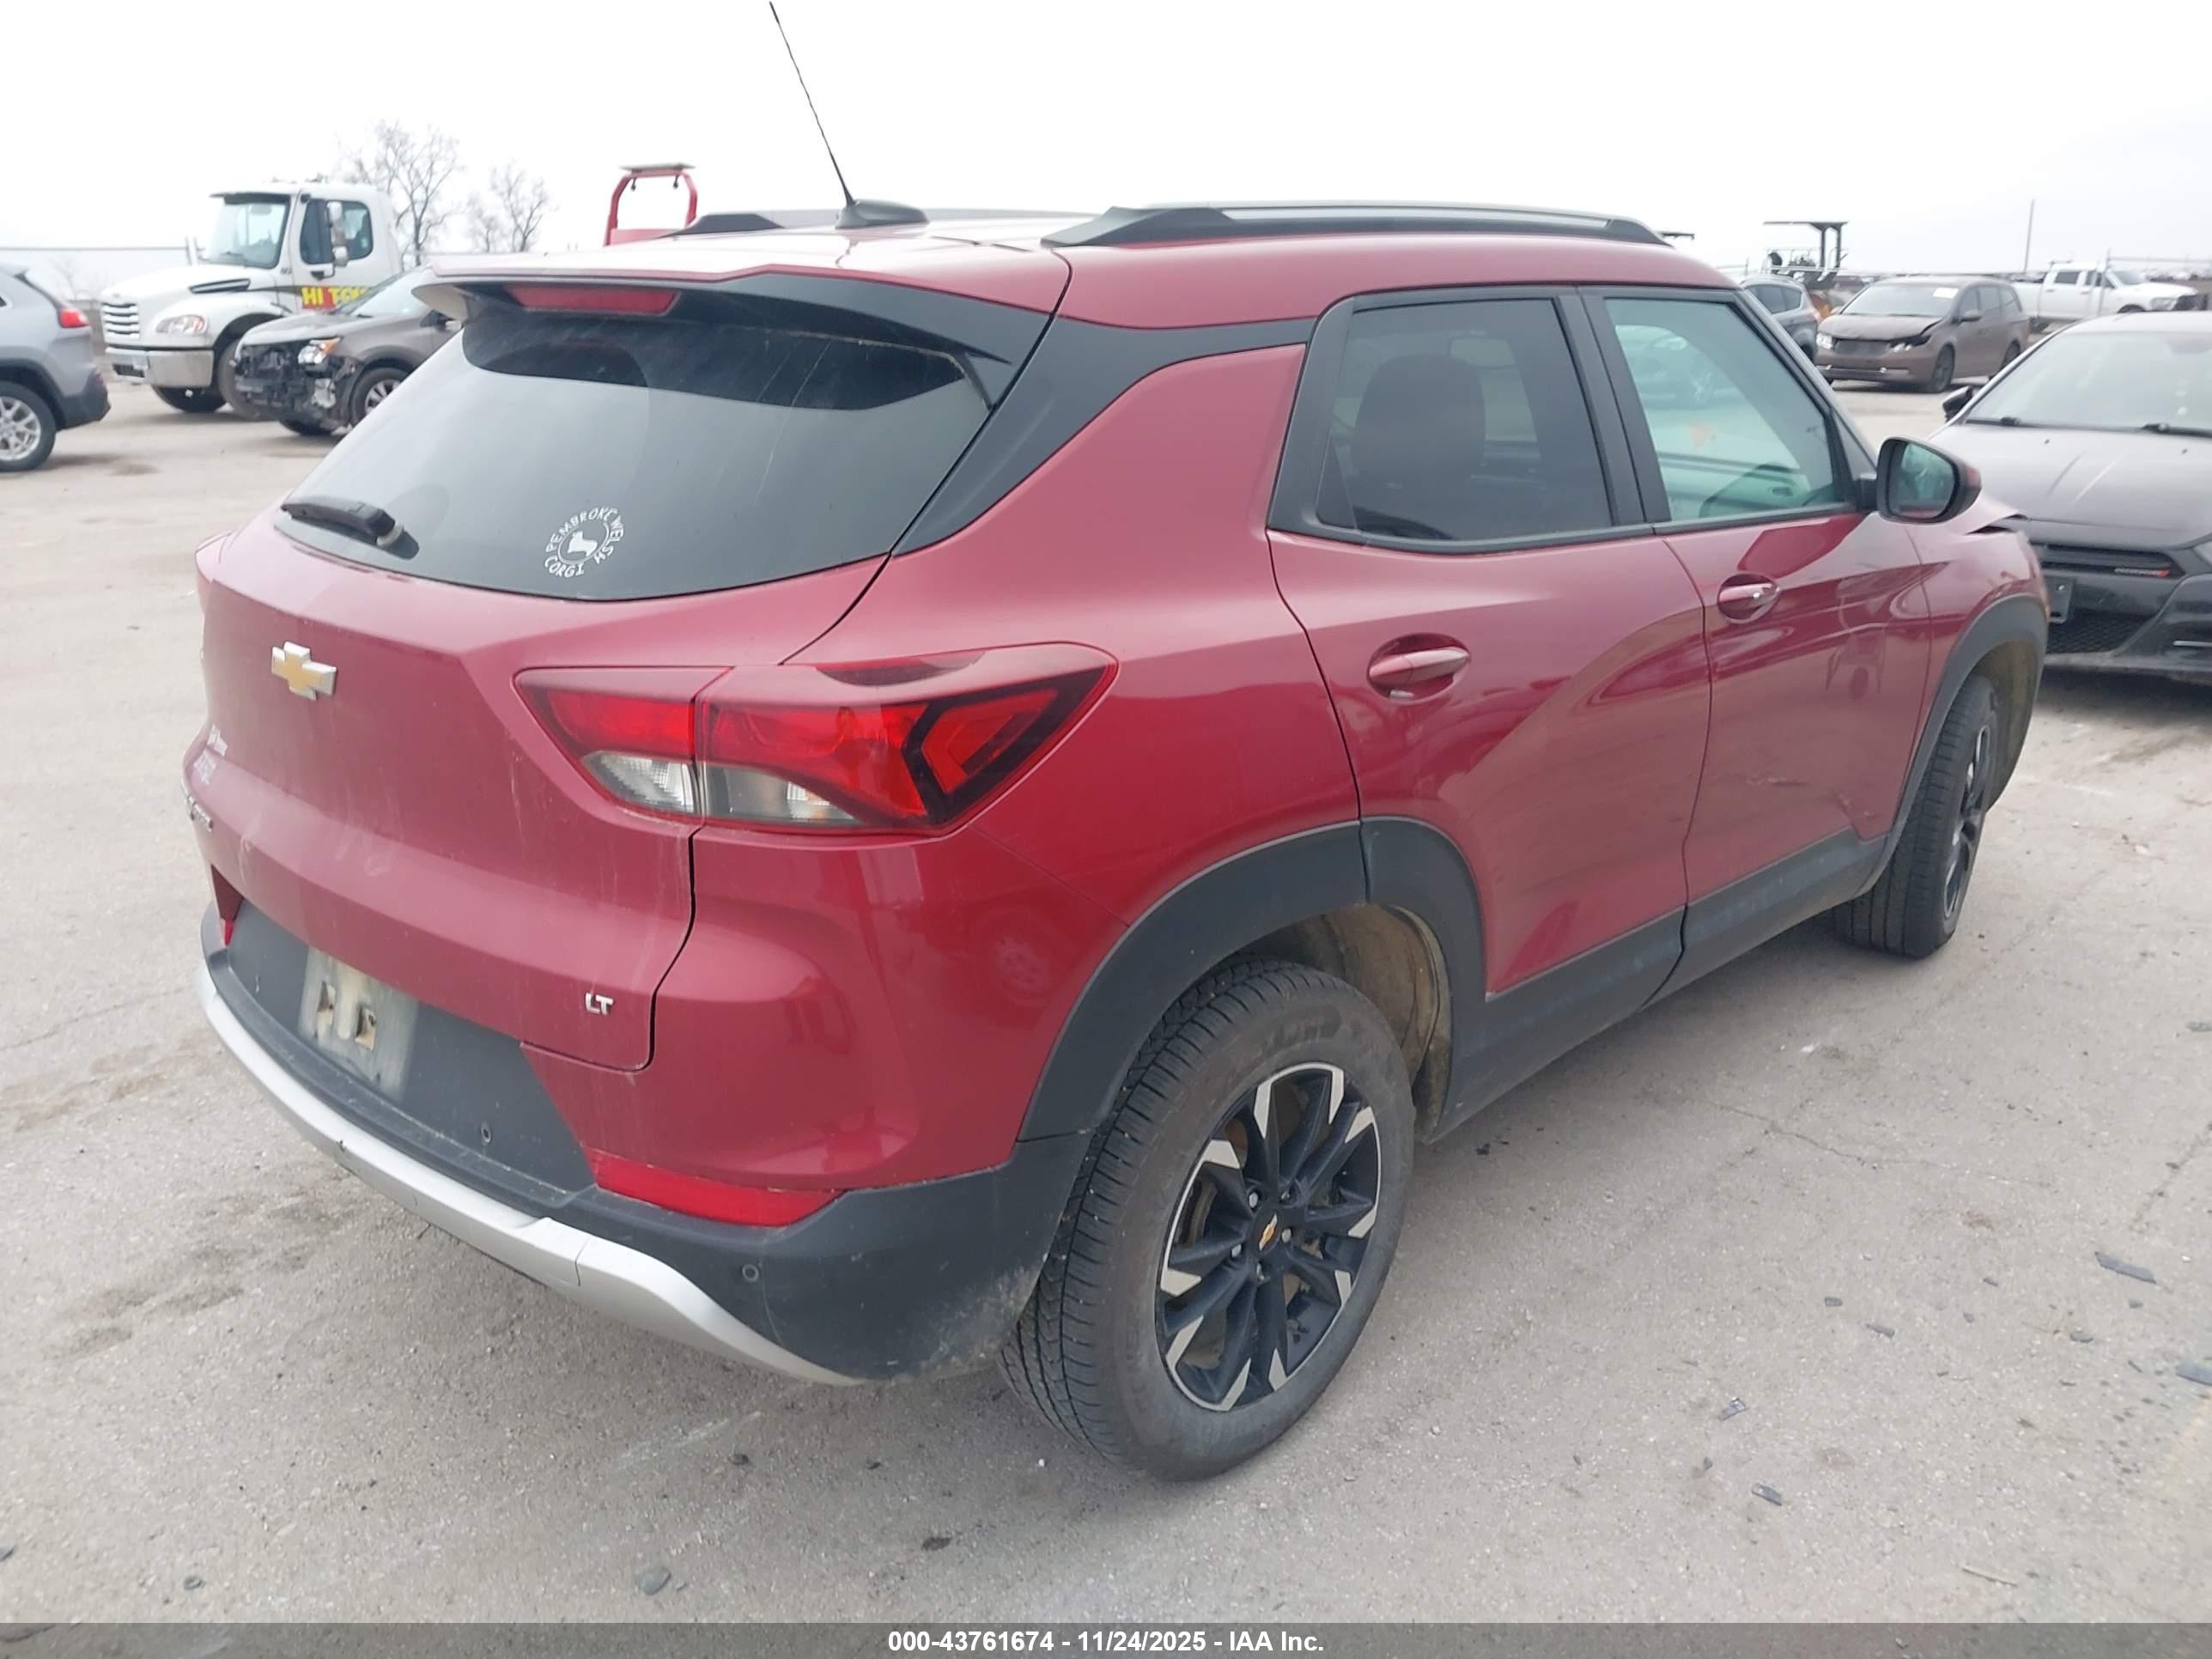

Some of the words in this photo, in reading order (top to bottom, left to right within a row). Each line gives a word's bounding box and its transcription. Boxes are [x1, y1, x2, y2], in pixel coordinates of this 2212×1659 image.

[301, 286, 324, 306] HI
[545, 507, 618, 553] PEMBROKE
[593, 515, 624, 564] WELSH
[544, 555, 584, 578] CORGI
[585, 992, 614, 1016] LT
